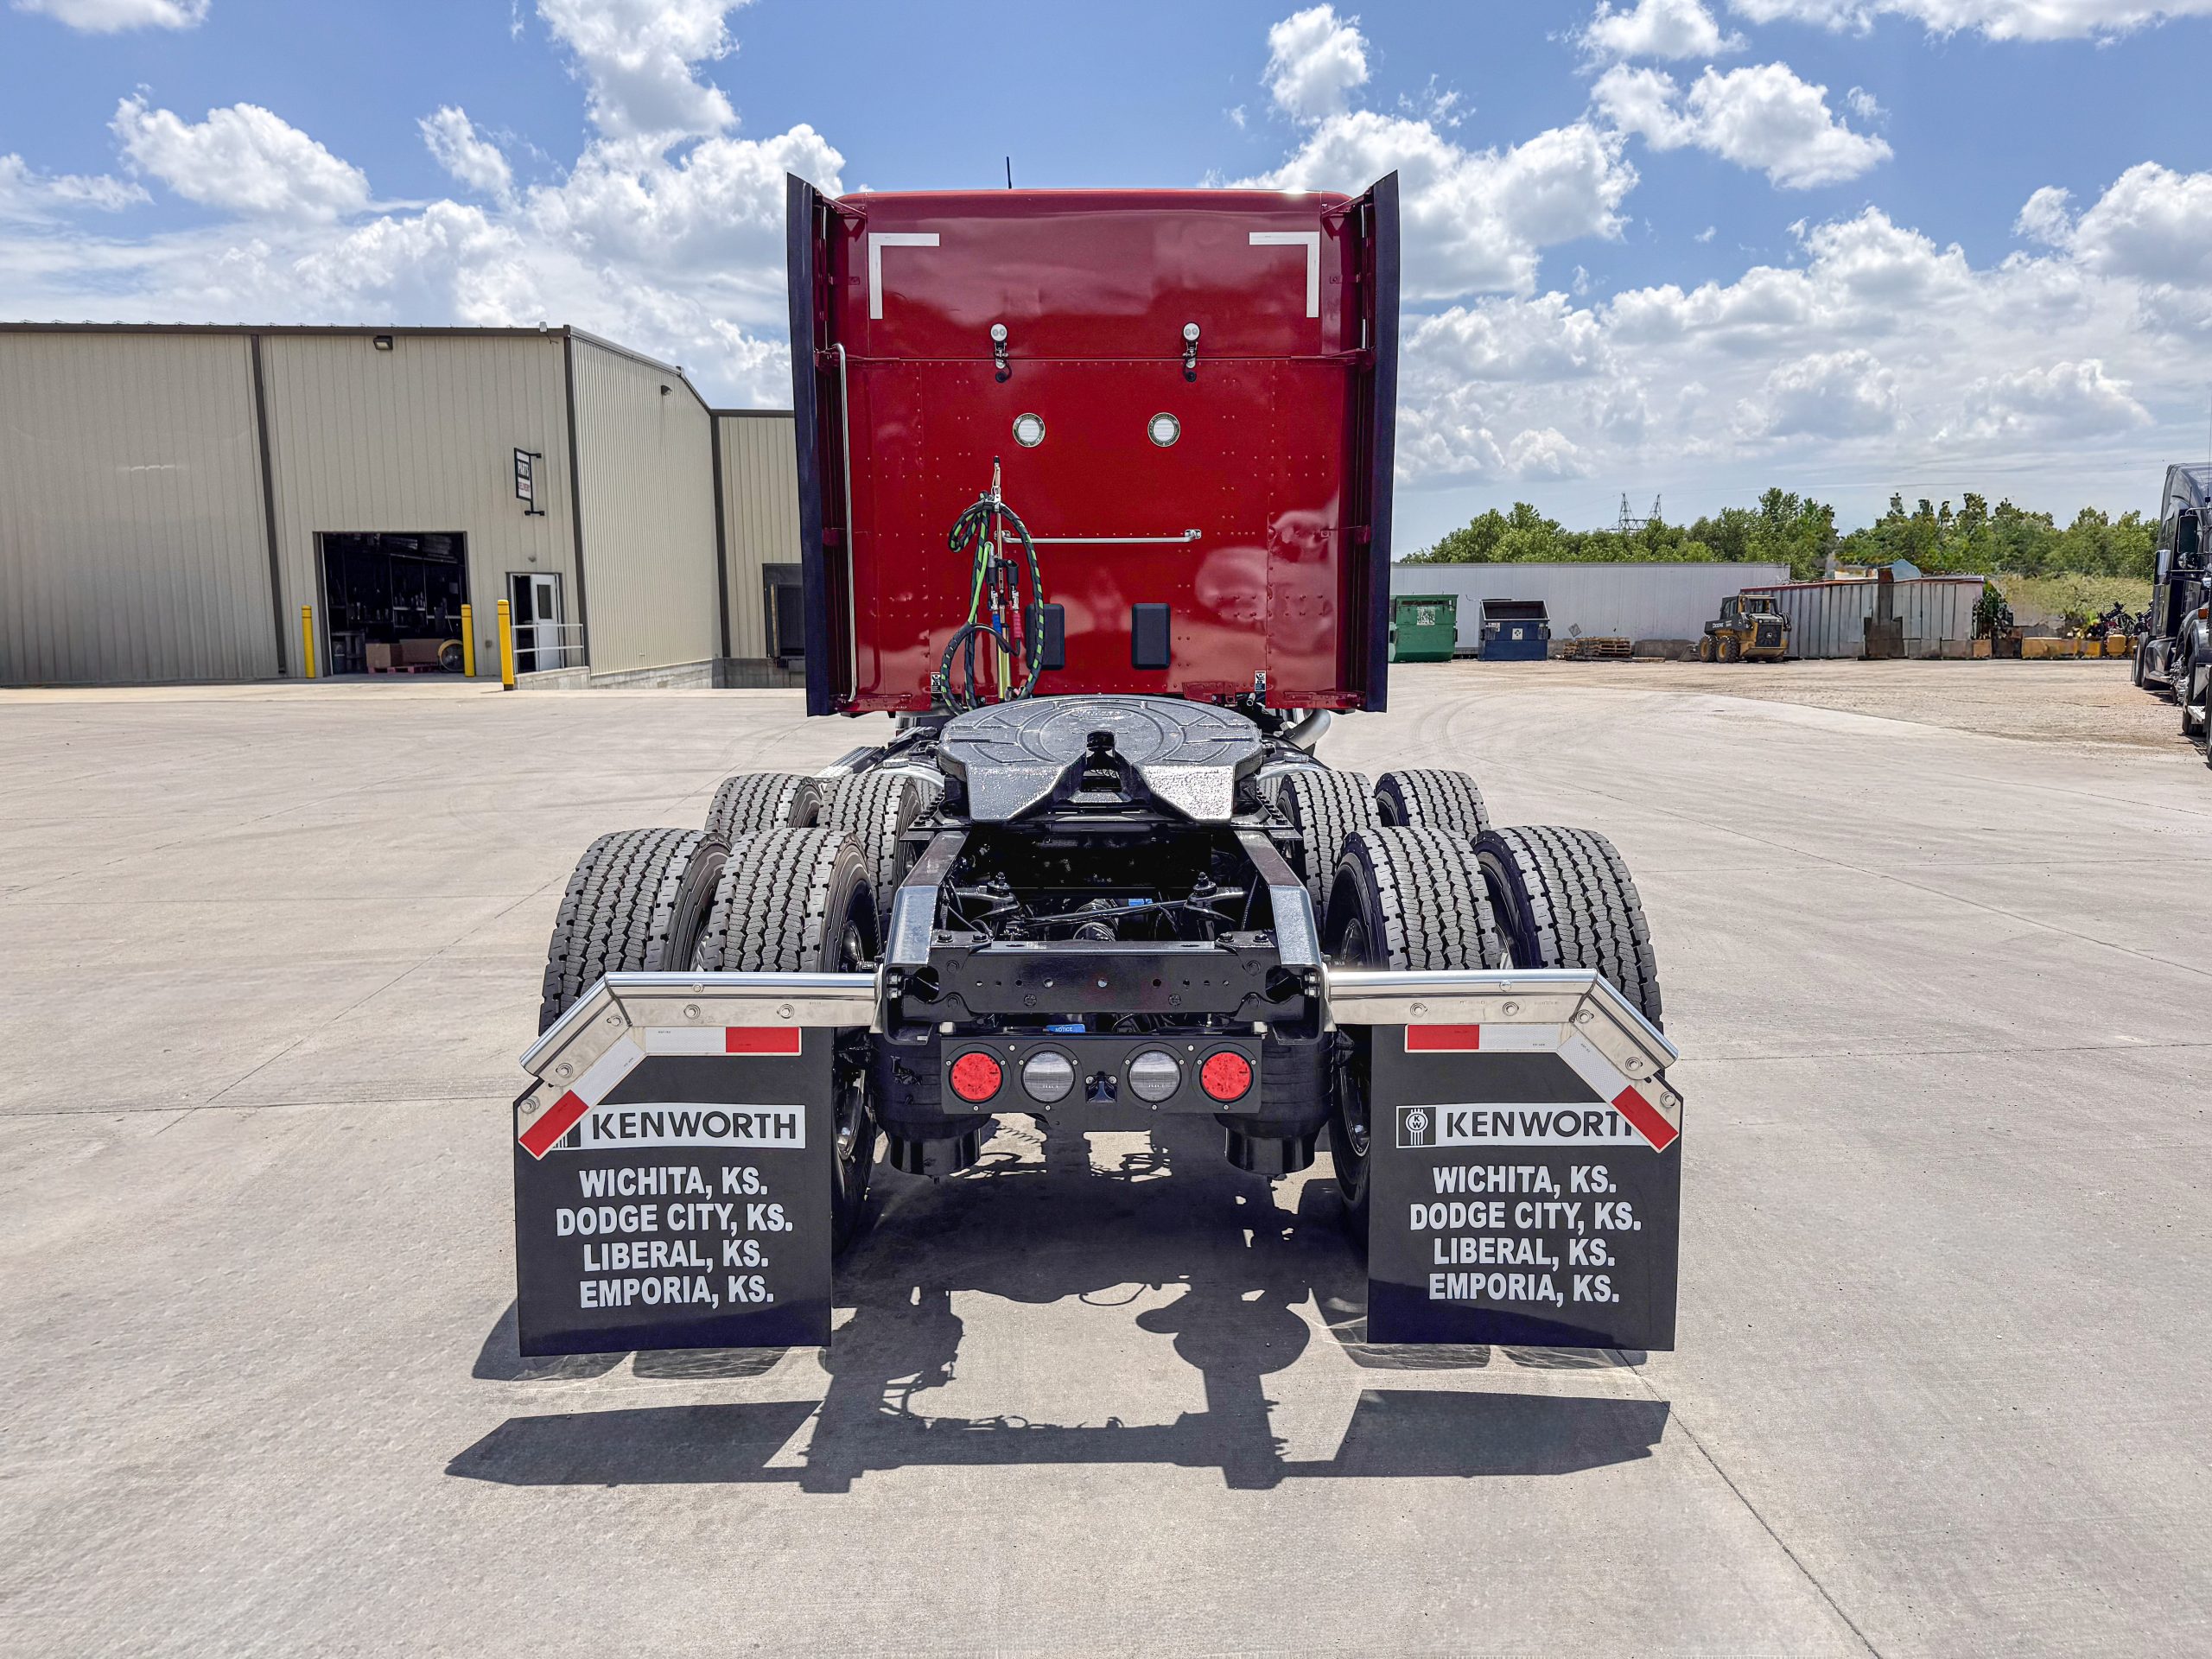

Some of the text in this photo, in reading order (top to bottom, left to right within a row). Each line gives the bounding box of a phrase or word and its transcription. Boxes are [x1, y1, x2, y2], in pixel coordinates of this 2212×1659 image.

[518, 461, 530, 477] PARTS
[592, 1111, 796, 1140] KENWORTH
[1446, 1110, 1632, 1138] KENWORT
[579, 1166, 768, 1200] WICHITA, KS.
[1433, 1166, 1617, 1199] WICHITA, KS.
[556, 1203, 793, 1236] DODGE CITY, KS.
[1409, 1202, 1642, 1235] DODGE CITY, KS.
[583, 1239, 769, 1273] LIBERAL, KS.
[1433, 1238, 1616, 1271] LIBERAL, KS.
[580, 1275, 774, 1309] EMPORIA, KS.
[1429, 1273, 1620, 1307] EMPORIA, KS.
